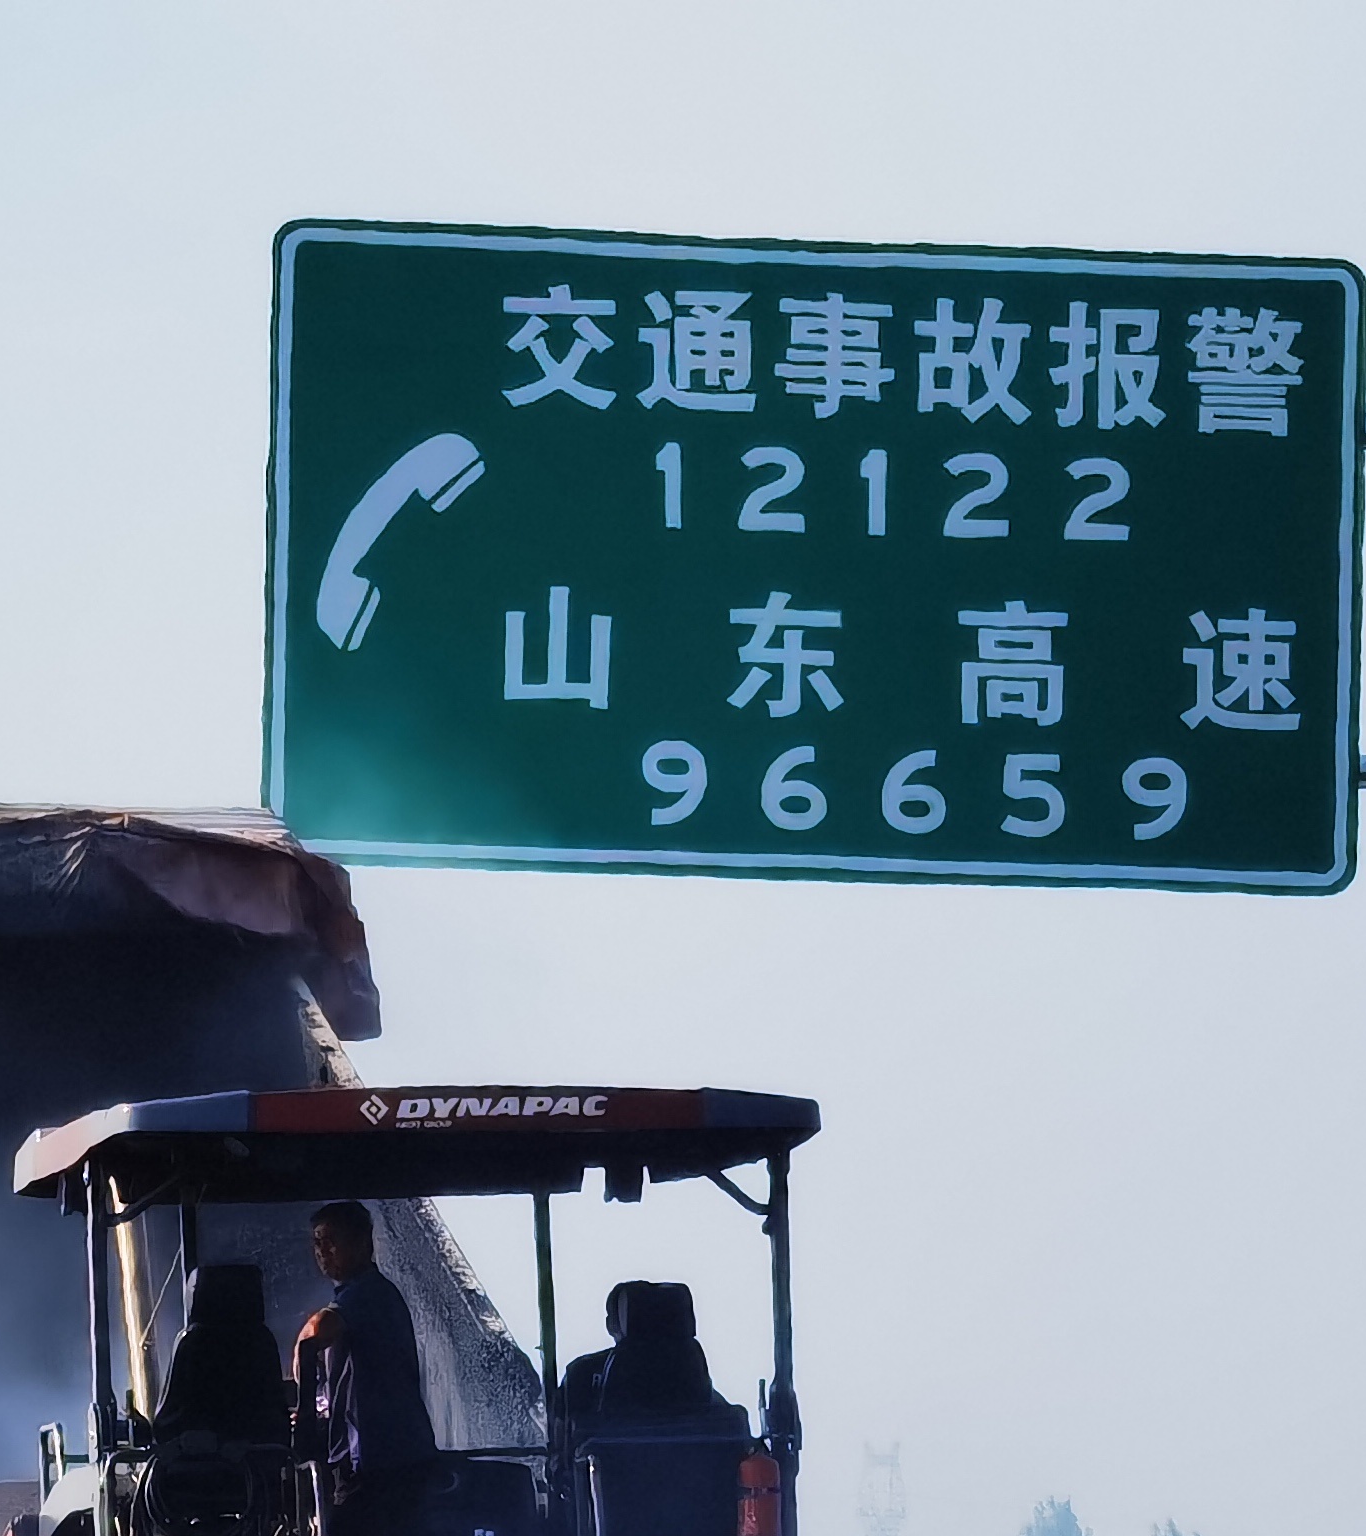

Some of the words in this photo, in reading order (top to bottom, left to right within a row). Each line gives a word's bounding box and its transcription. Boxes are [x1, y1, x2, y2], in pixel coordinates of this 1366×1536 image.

[501, 284, 1304, 436] 交通事故报警
[655, 442, 1131, 541] 12122
[503, 585, 1302, 731] 山东高速
[641, 740, 1188, 841] 96659
[396, 1095, 609, 1118] DYNAPAC
